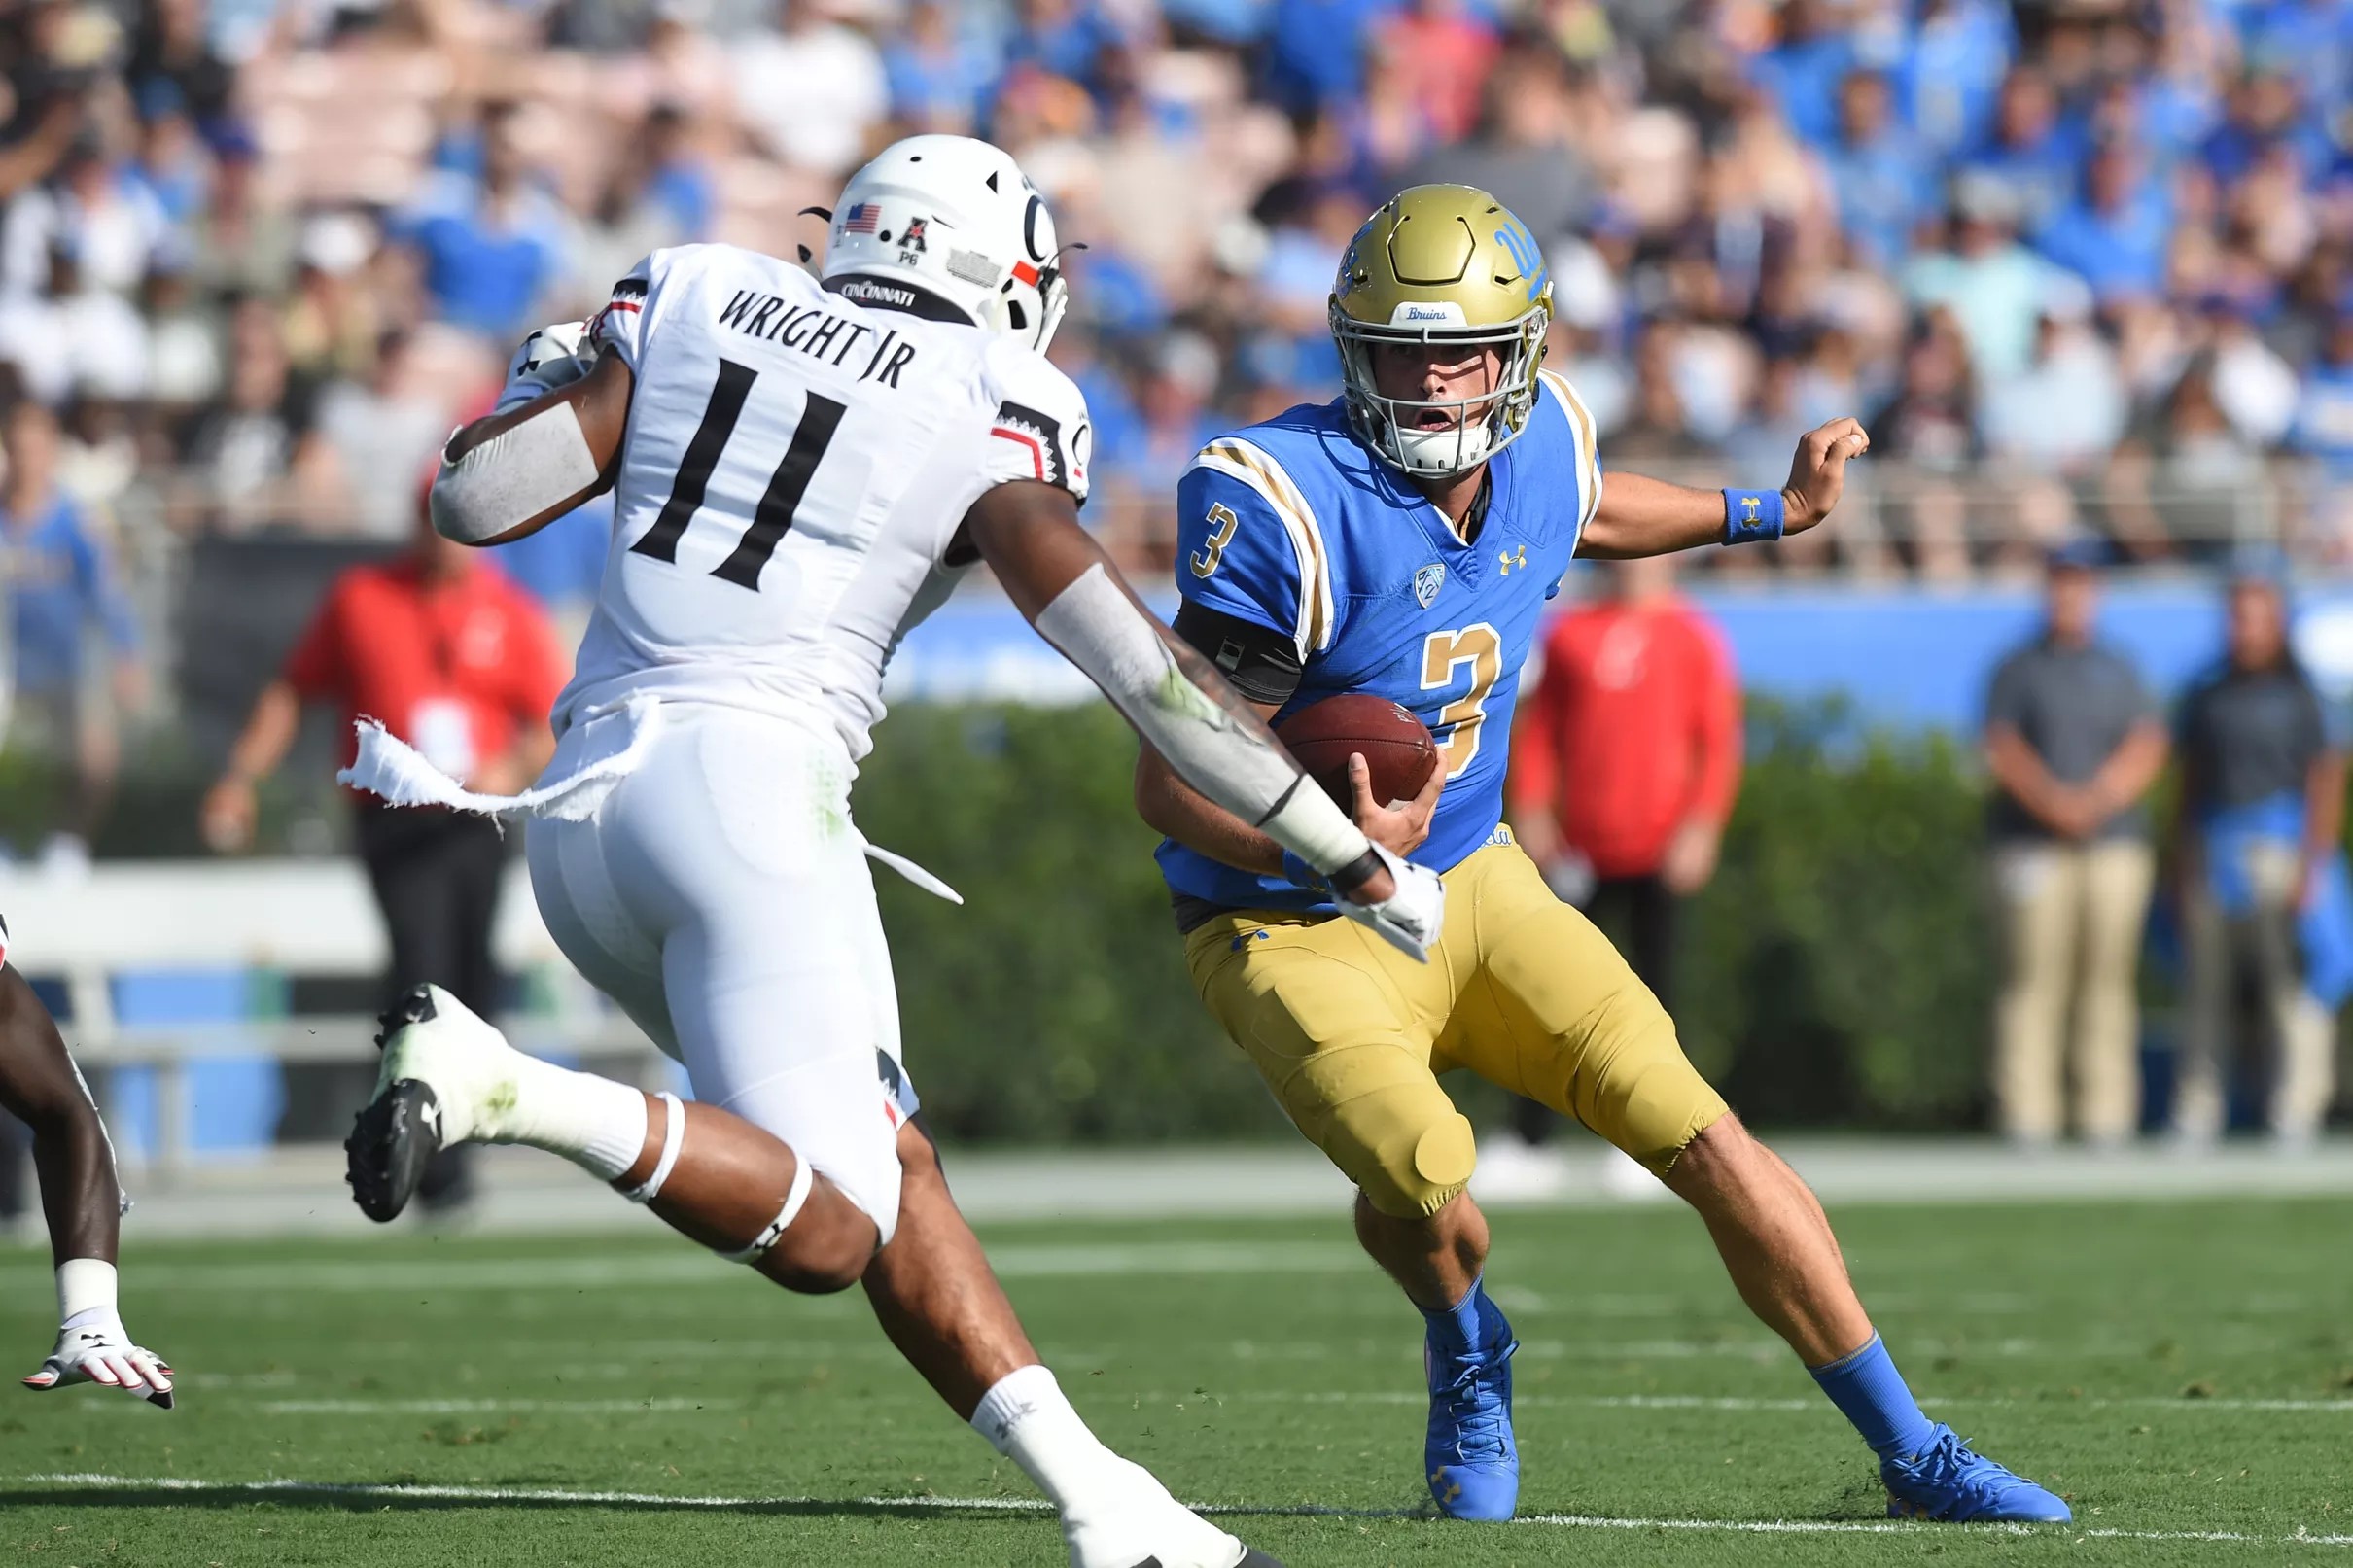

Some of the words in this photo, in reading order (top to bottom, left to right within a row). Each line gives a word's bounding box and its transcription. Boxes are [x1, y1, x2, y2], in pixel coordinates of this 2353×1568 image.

[841, 280, 916, 307] CINCINNATI
[899, 251, 919, 266] P6
[719, 290, 872, 366] WRIGHT
[857, 330, 916, 389] JR
[1406, 307, 1447, 321] Bruins
[628, 356, 848, 594] 11
[1189, 501, 1239, 579] 3
[1420, 622, 1503, 780] 3
